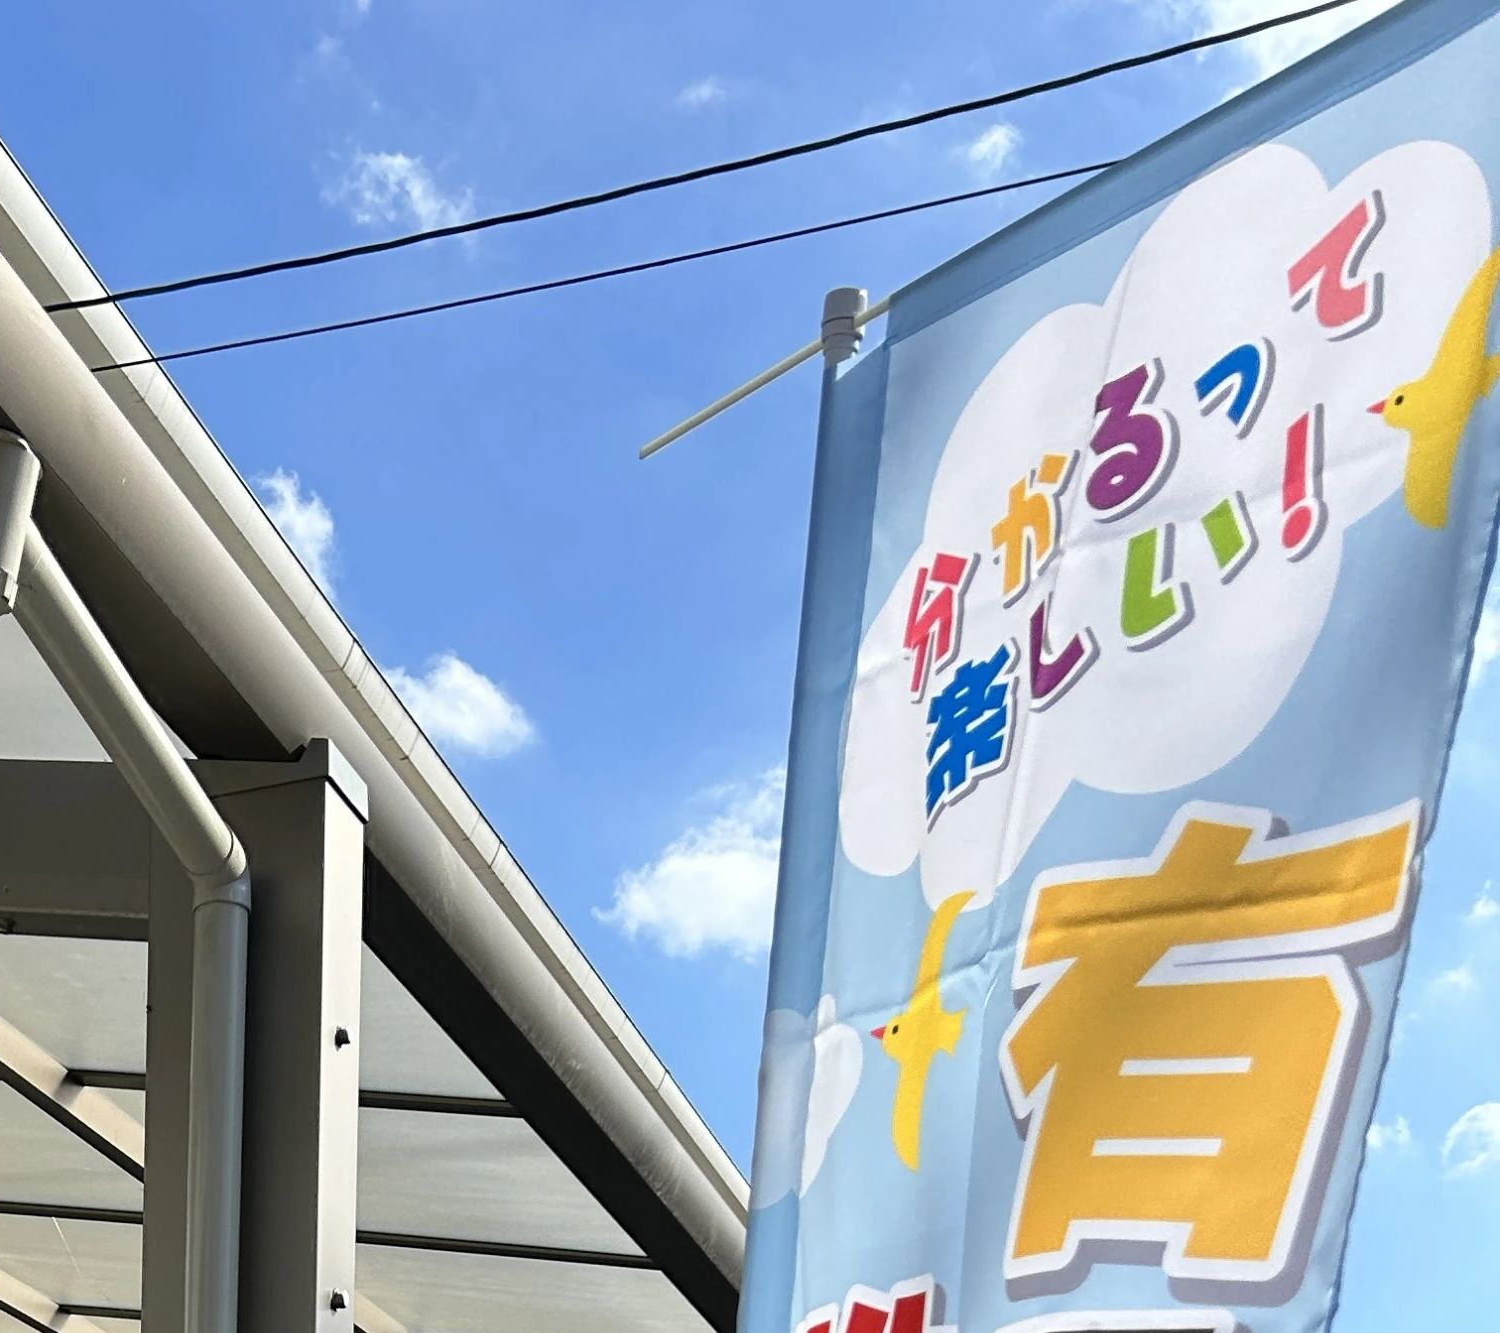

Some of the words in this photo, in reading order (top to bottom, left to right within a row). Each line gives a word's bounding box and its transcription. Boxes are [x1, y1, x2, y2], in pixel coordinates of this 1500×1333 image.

[902, 197, 1374, 692] 分かるって
[926, 412, 1326, 818] 楽しい！
